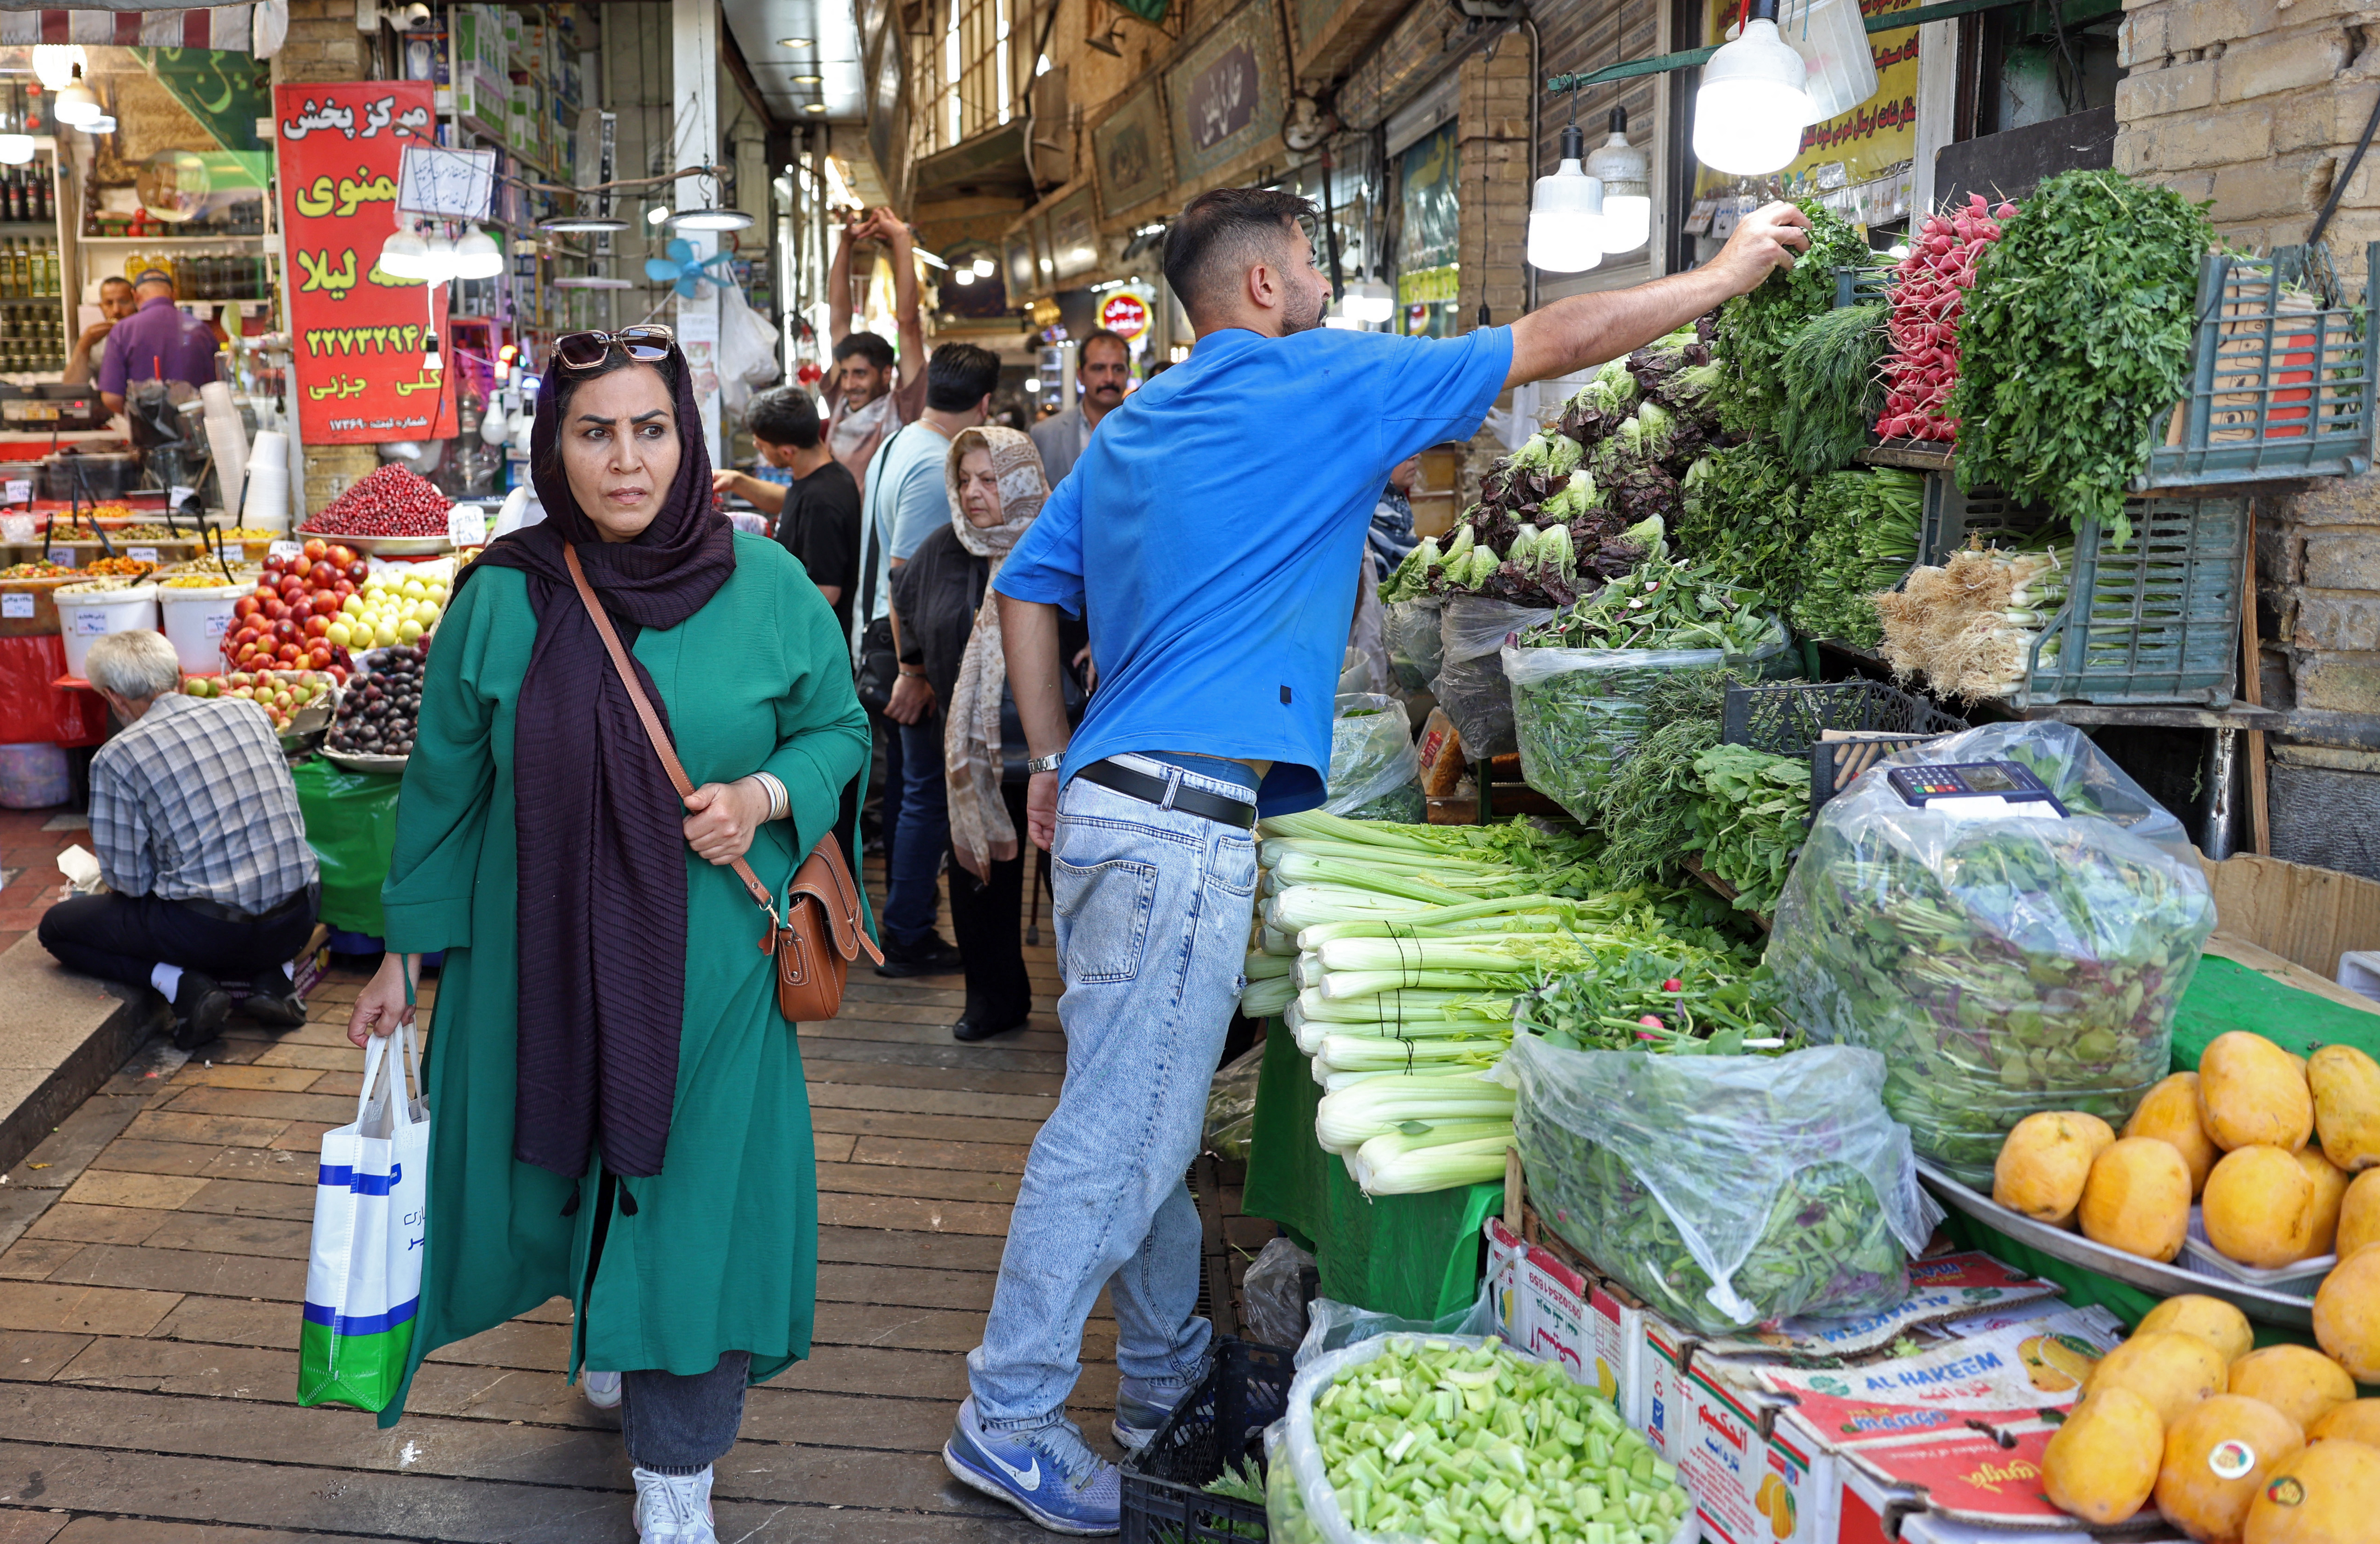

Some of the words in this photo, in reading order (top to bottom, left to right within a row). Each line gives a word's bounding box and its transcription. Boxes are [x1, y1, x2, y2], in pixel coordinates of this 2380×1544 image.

[283, 98, 356, 140] پخش
[360, 95, 429, 138] مرکز
[295, 166, 398, 218] منوی
[297, 248, 358, 300] لیلا
[308, 374, 367, 400] جزئی
[395, 369, 442, 396] کلی
[395, 415, 428, 429] شماره
[1529, 1272, 1582, 1320] 09302541659
[1866, 1376, 1898, 1391] AL
[1898, 1352, 2003, 1387] HAKEEM
